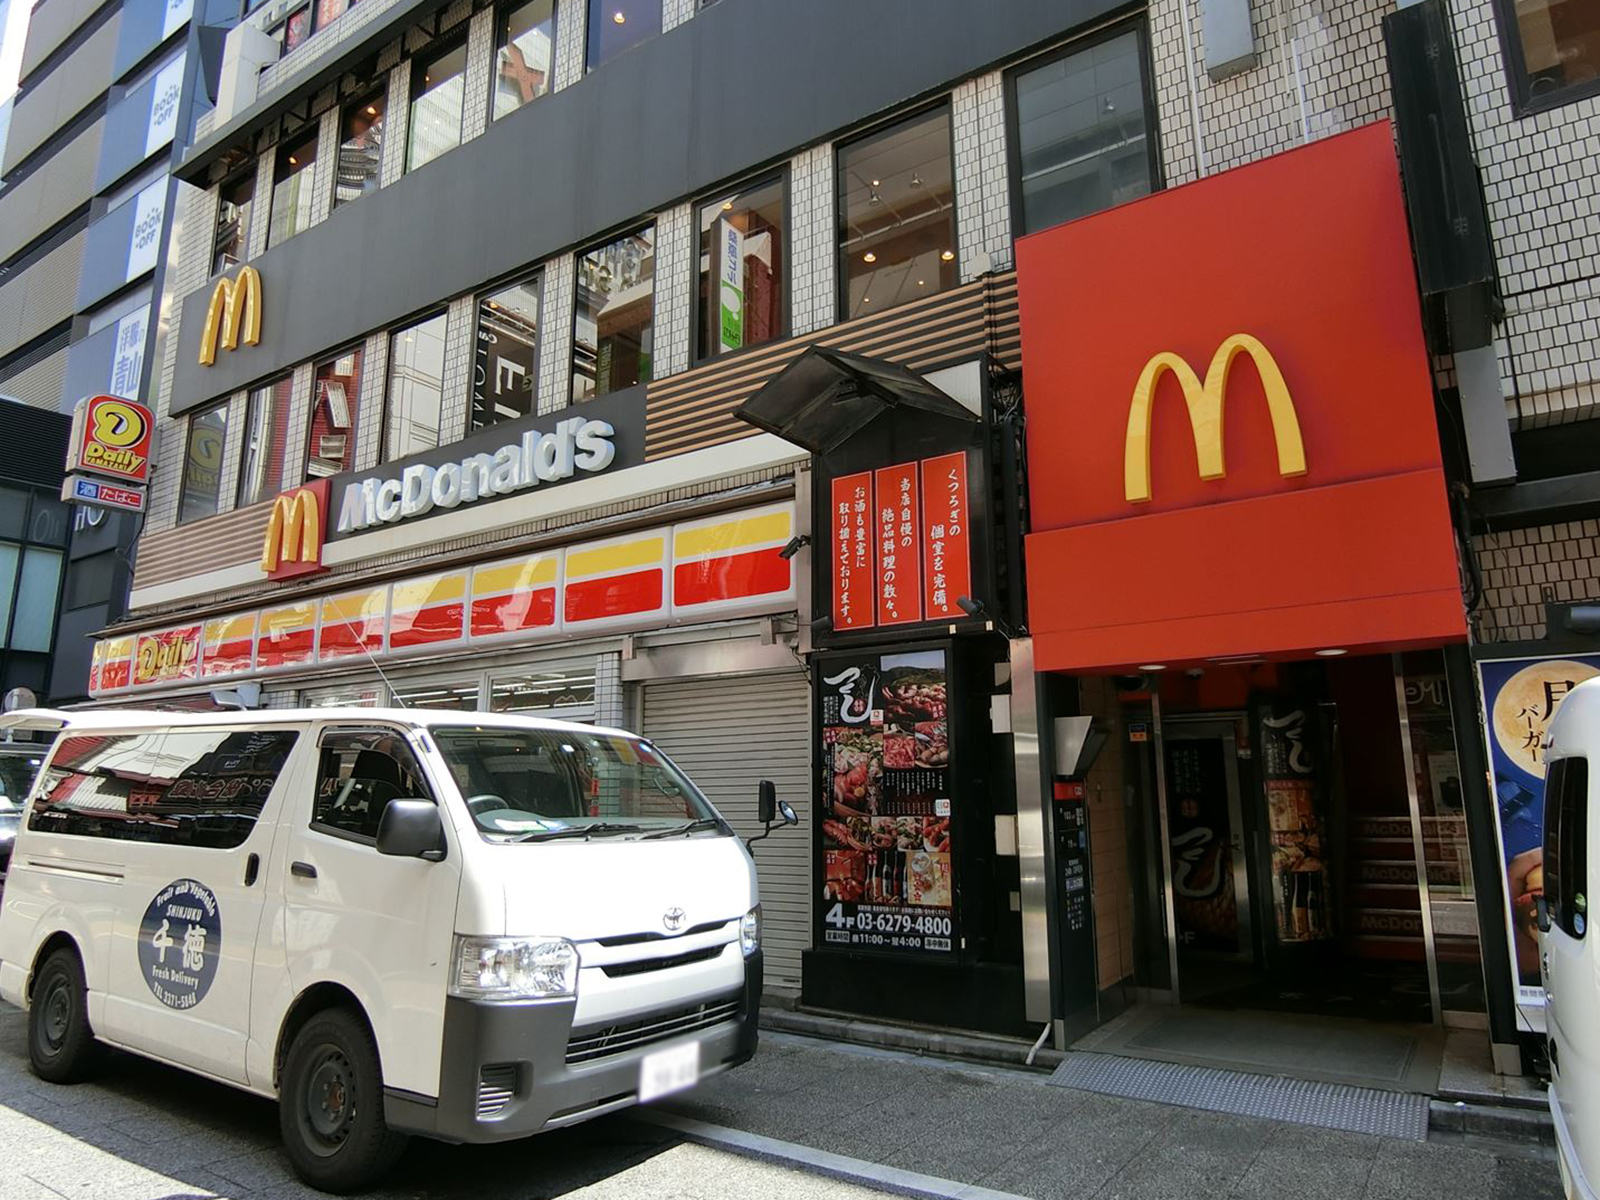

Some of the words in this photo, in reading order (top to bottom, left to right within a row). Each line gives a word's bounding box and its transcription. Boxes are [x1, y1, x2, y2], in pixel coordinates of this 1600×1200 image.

[153, 89, 179, 116] BOOK
[157, 105, 174, 125] OFF
[135, 210, 161, 237] BOOK
[139, 230, 156, 249] OFF
[85, 441, 146, 473] Daily
[86, 456, 128, 471] YAMAZAKI
[80, 483, 97, 498] 酒
[337, 416, 616, 533] McDonald's
[100, 488, 140, 506] たばこ
[900, 477, 913, 547] 当店自慢の
[947, 468, 961, 536] くつろぎの
[854, 487, 866, 568] お酒も豊富に
[838, 502, 852, 625] 取り揃えております。
[882, 508, 898, 619] 絶品料理の数々。
[930, 524, 948, 612] 個室を完備。
[138, 636, 196, 682] Daily
[1516, 704, 1544, 762] バーガー
[157, 887, 174, 907] Fruit
[175, 881, 189, 895] and
[190, 882, 216, 917] Vegetable
[166, 904, 203, 922] SHINJUKU
[825, 902, 855, 928] 4F
[857, 912, 952, 935] 03-6279-4800
[152, 918, 207, 971] 千徳
[152, 965, 169, 980] Fresh
[171, 969, 199, 990] Delivery
[153, 981, 163, 999] TEL
